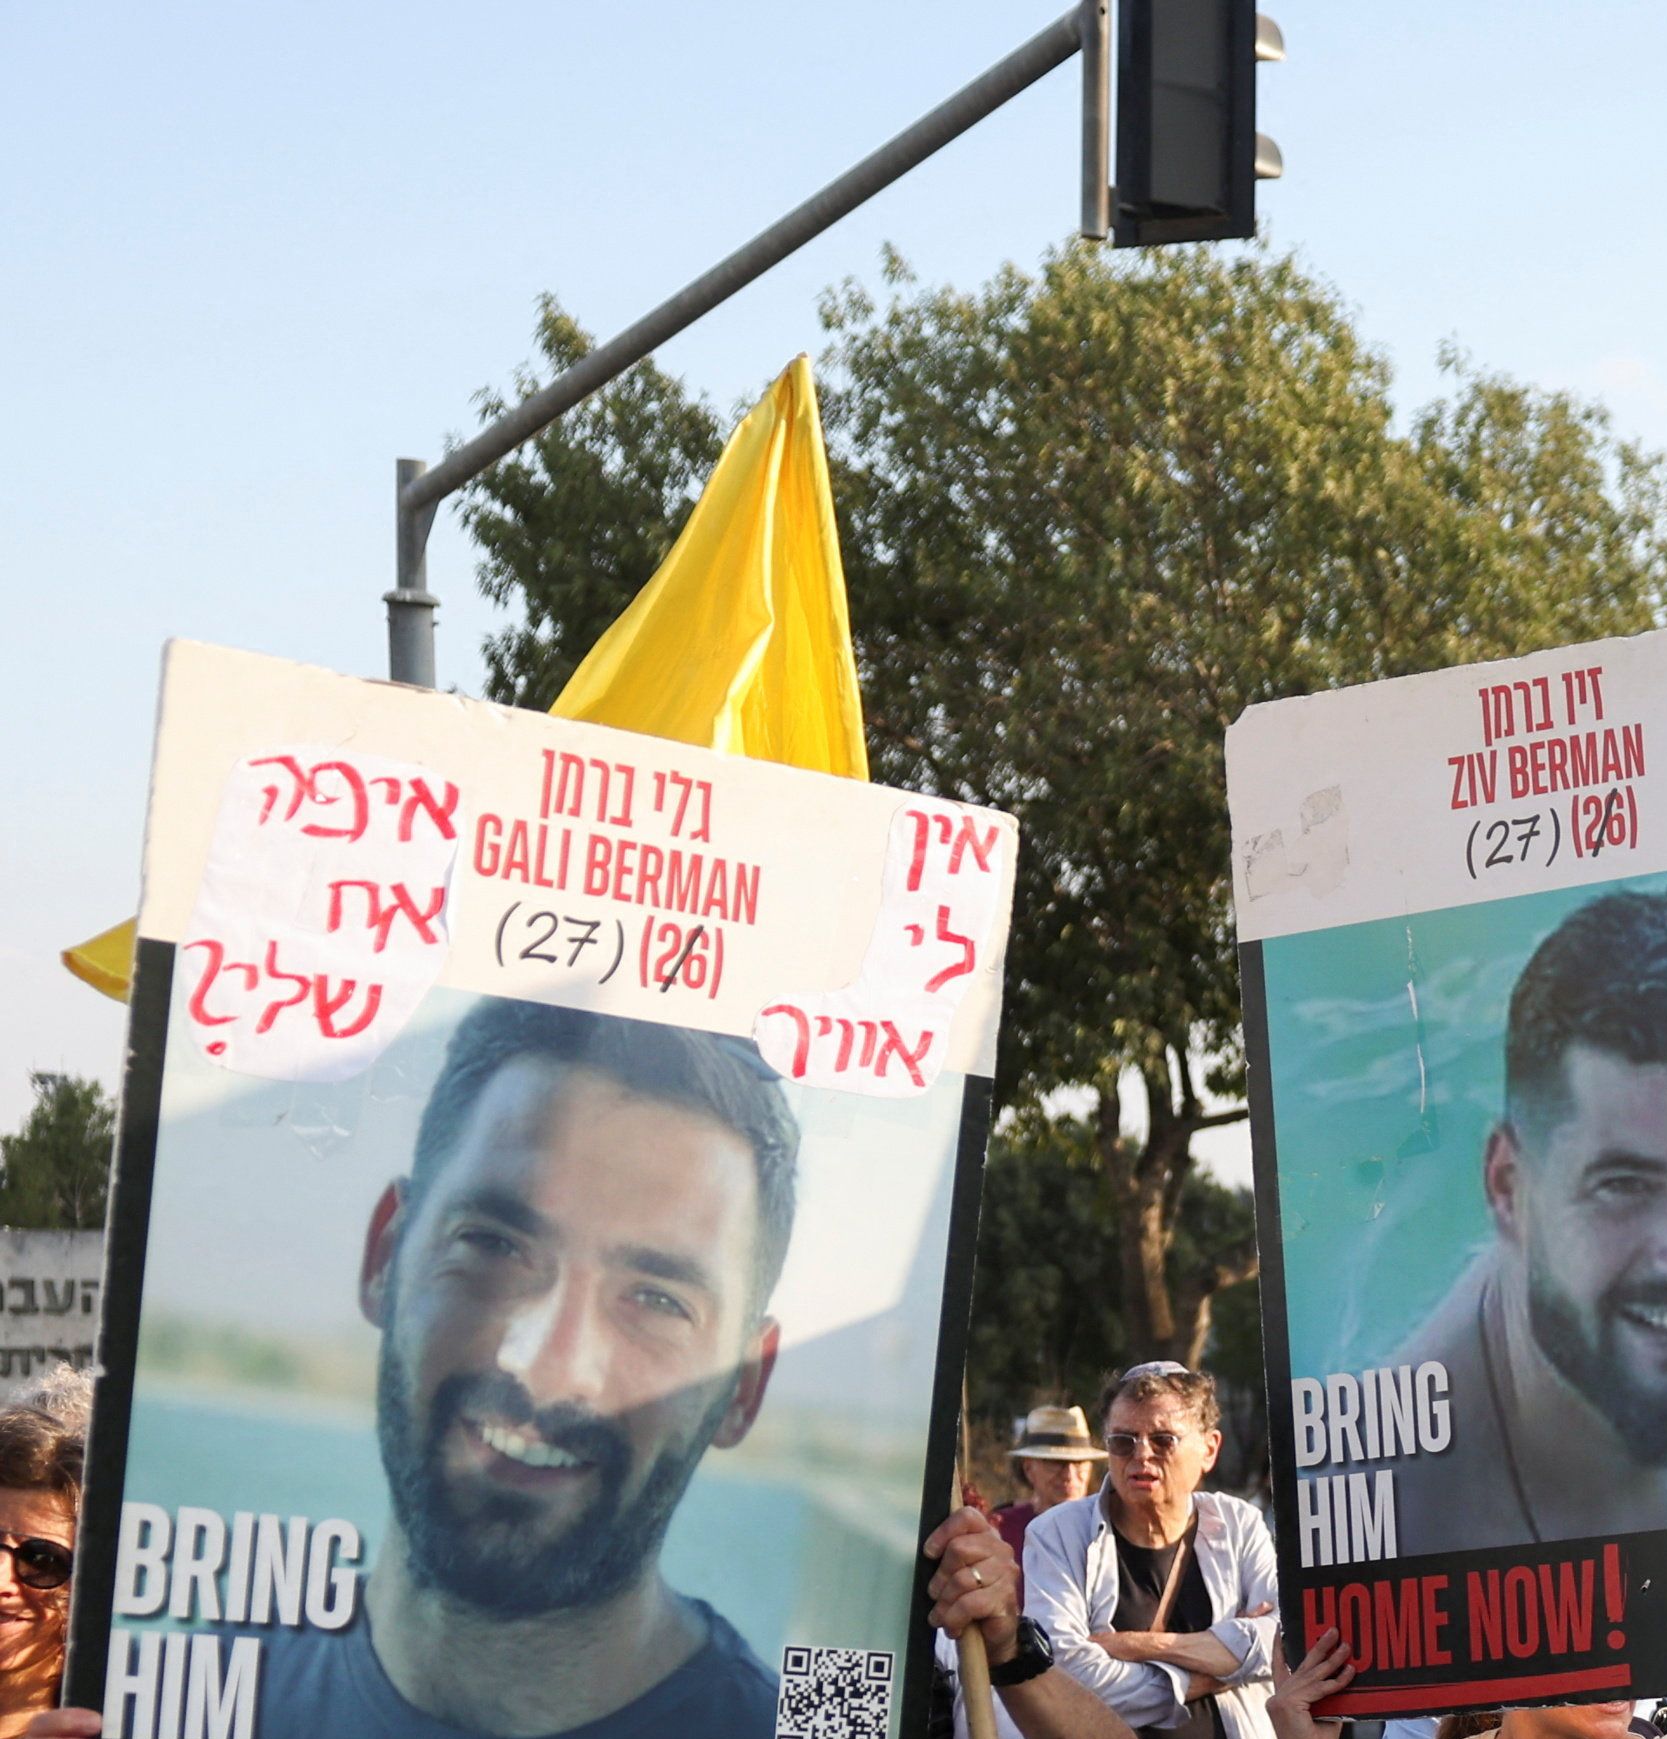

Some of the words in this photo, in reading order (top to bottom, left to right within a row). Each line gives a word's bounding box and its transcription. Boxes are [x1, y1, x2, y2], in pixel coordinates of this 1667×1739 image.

[1479, 675, 1554, 747] ברמן
[1564, 666, 1604, 725] זיו
[247, 755, 461, 844] איפה
[541, 748, 635, 828] ברמן
[653, 764, 713, 843] גלי
[1447, 750, 1498, 811] ZIV
[1508, 723, 1646, 801] BERMAN
[474, 813, 571, 890] GALI
[583, 839, 761, 926] BERMAN
[906, 810, 999, 891] אין
[1465, 808, 1561, 880] (27)
[1571, 785, 1638, 859] (26)
[326, 879, 447, 955] אח
[494, 901, 625, 985] (27)
[639, 916, 724, 999] (26)
[904, 905, 976, 993] לי
[761, 1003, 934, 1088] אוויר
[1293, 1361, 1452, 1468] BRING
[1297, 1470, 1398, 1569] HIM
[114, 1502, 361, 1630] BRING
[1303, 1574, 1453, 1676] HOME
[1467, 1542, 1628, 1664] NOW!
